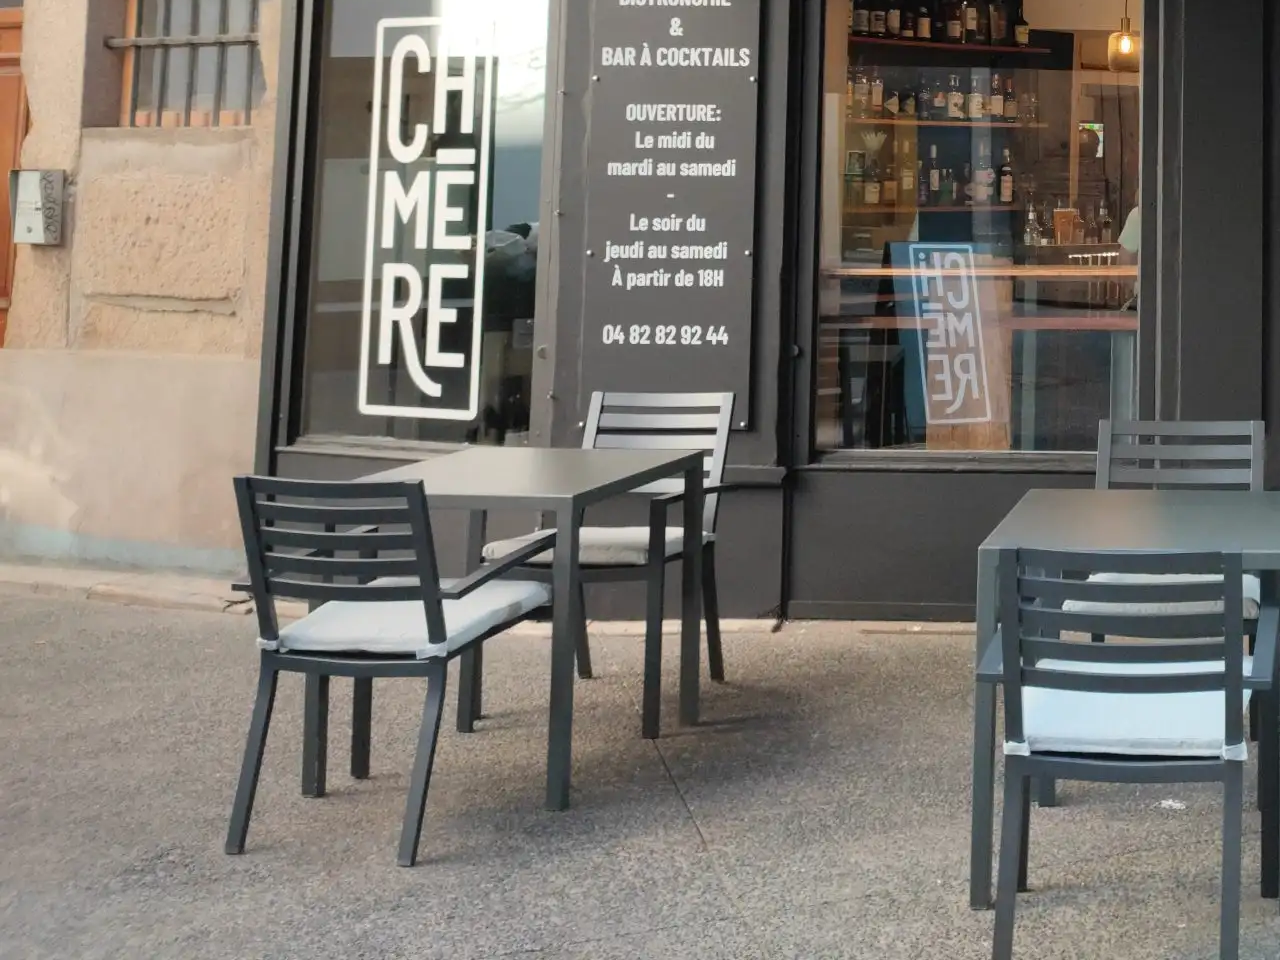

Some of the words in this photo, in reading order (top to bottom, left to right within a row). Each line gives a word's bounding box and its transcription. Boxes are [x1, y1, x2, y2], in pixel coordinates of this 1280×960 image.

[669, 16, 684, 37] &
[601, 47, 636, 68] BAR
[639, 42, 653, 67] À
[656, 48, 750, 68] COCKTAILS
[625, 103, 722, 122] OUVERTURE:
[635, 130, 655, 149] Le
[657, 130, 692, 149] midi
[694, 131, 715, 149] du
[607, 158, 653, 177] mardi
[656, 162, 676, 177] au
[679, 158, 737, 177] samedi
[629, 213, 649, 232] Le
[651, 213, 684, 232] soir
[686, 213, 706, 232] du
[603, 240, 644, 263] jeudi
[647, 245, 668, 259] au
[670, 241, 728, 260] samedi
[611, 264, 623, 286] À
[626, 268, 672, 291] partir
[674, 268, 694, 287] de
[697, 268, 724, 287] 18H
[602, 324, 625, 346] 04
[629, 324, 651, 346] 82
[654, 324, 677, 346] 82
[680, 325, 702, 346] 92
[705, 325, 729, 346] 44
